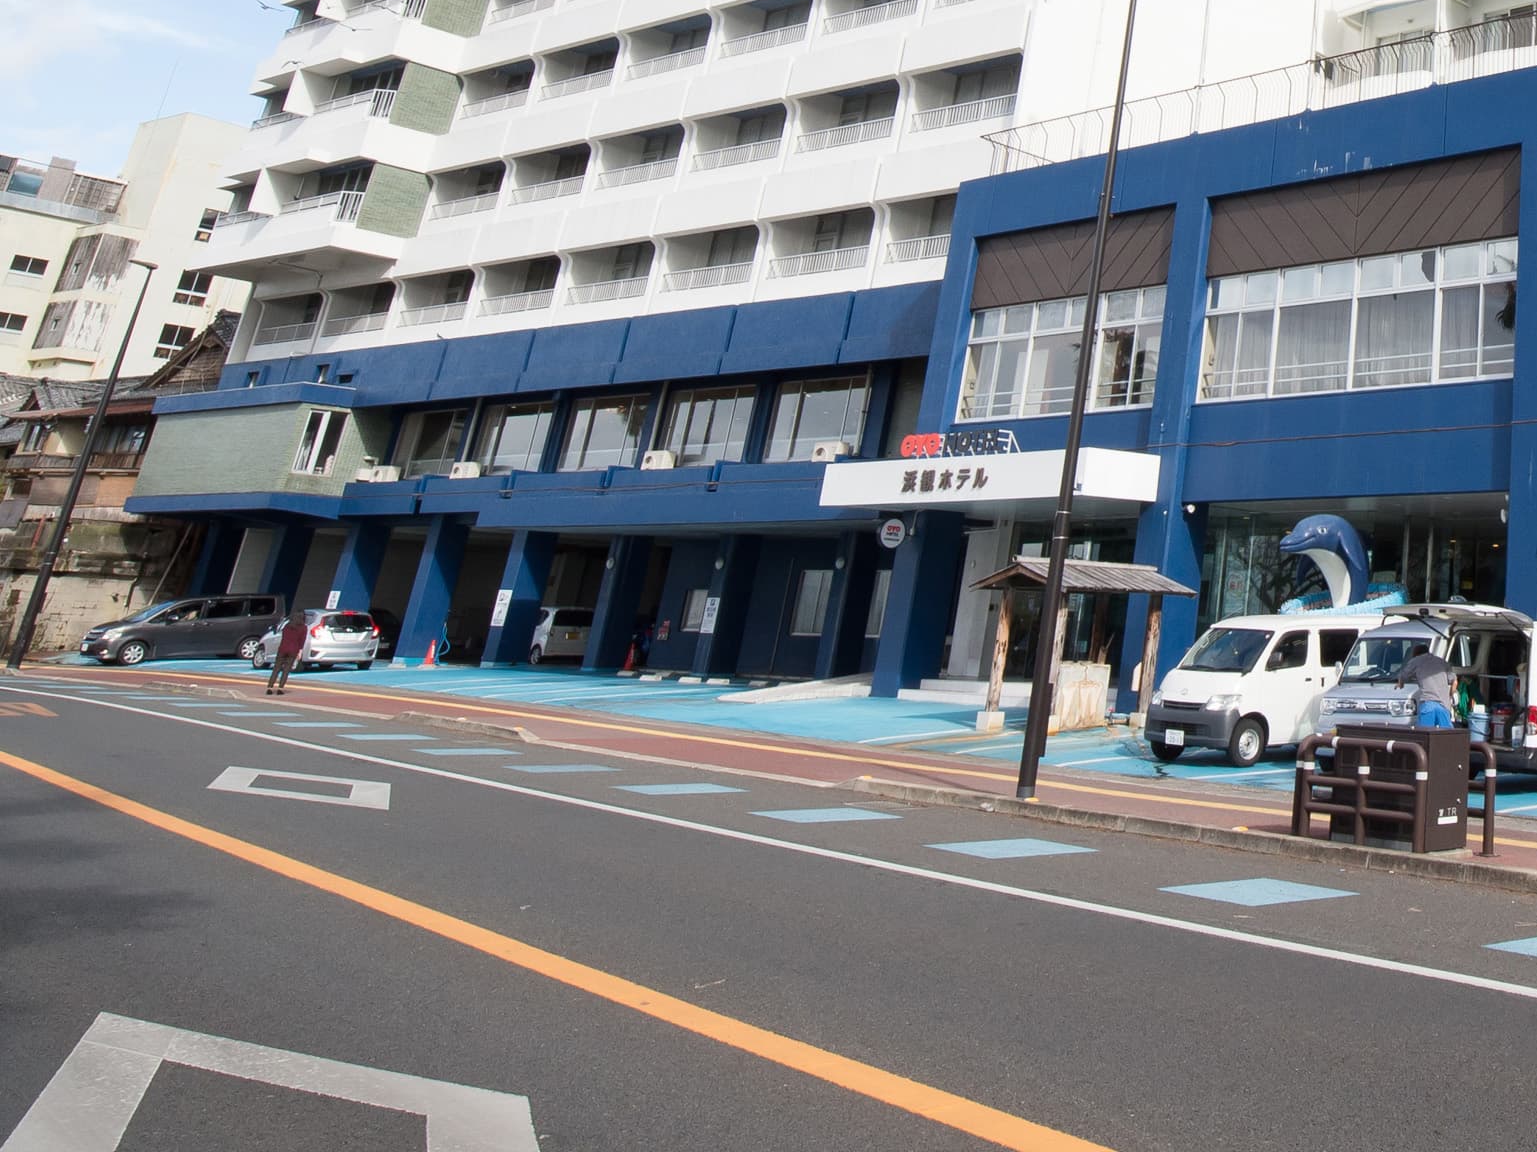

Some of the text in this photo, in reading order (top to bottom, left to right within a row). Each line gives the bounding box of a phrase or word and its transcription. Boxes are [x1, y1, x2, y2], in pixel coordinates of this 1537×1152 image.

[901, 432, 940, 457] OYO
[901, 467, 988, 493] 浜観ホテル
